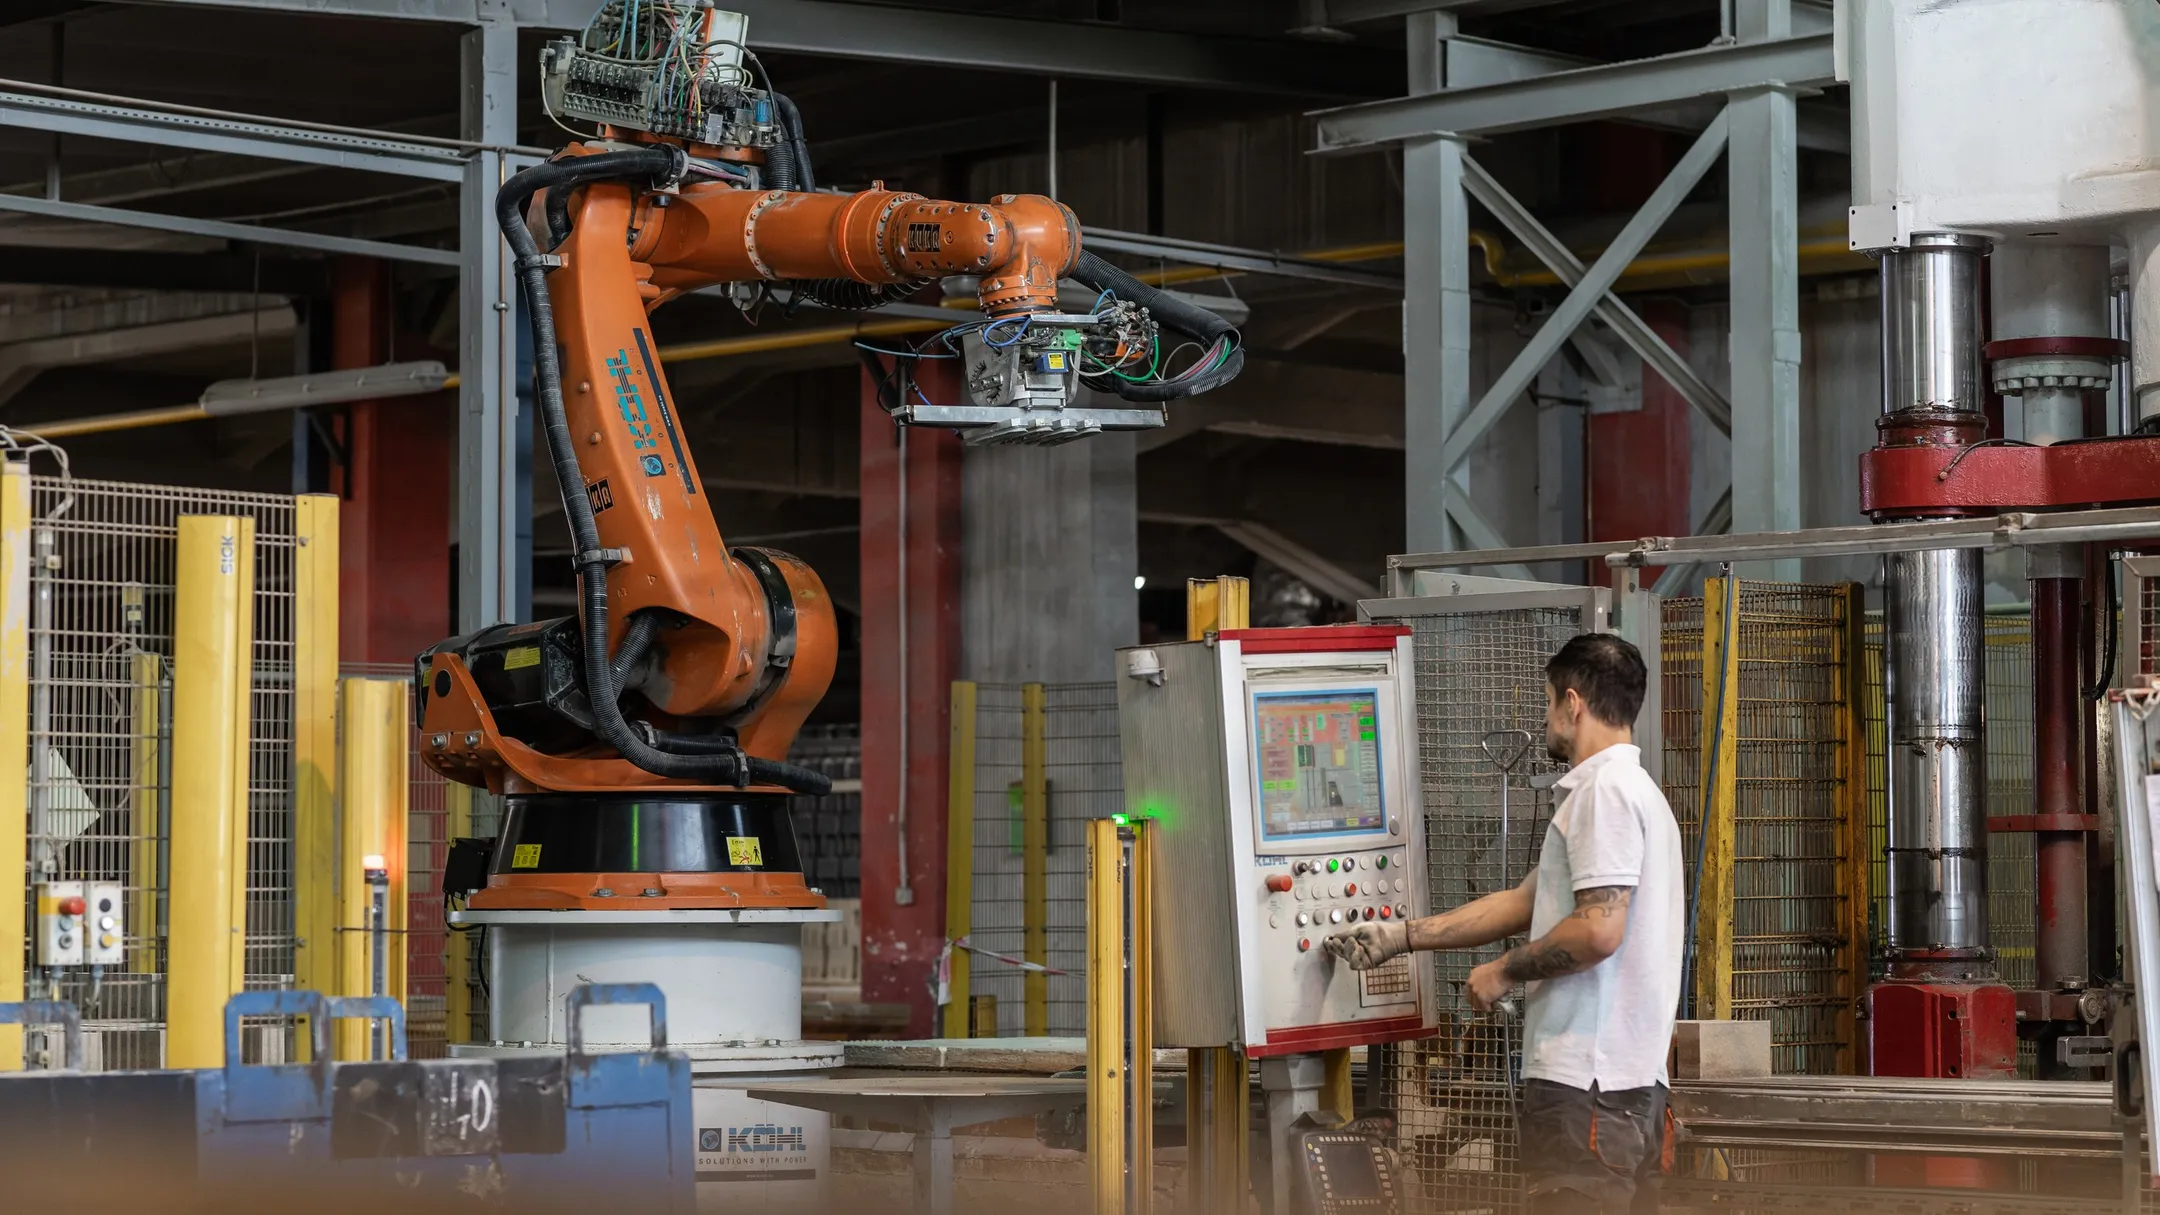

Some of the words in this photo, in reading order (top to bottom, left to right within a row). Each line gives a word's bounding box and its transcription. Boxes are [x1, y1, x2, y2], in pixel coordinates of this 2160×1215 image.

[907, 228, 941, 249] KUKA
[606, 349, 656, 449] KÖHL
[221, 535, 234, 575] SICK
[728, 1123, 807, 1152] KÖHL
[698, 1157, 755, 1166] SOLUTIONS
[784, 1156, 808, 1164] POWER
